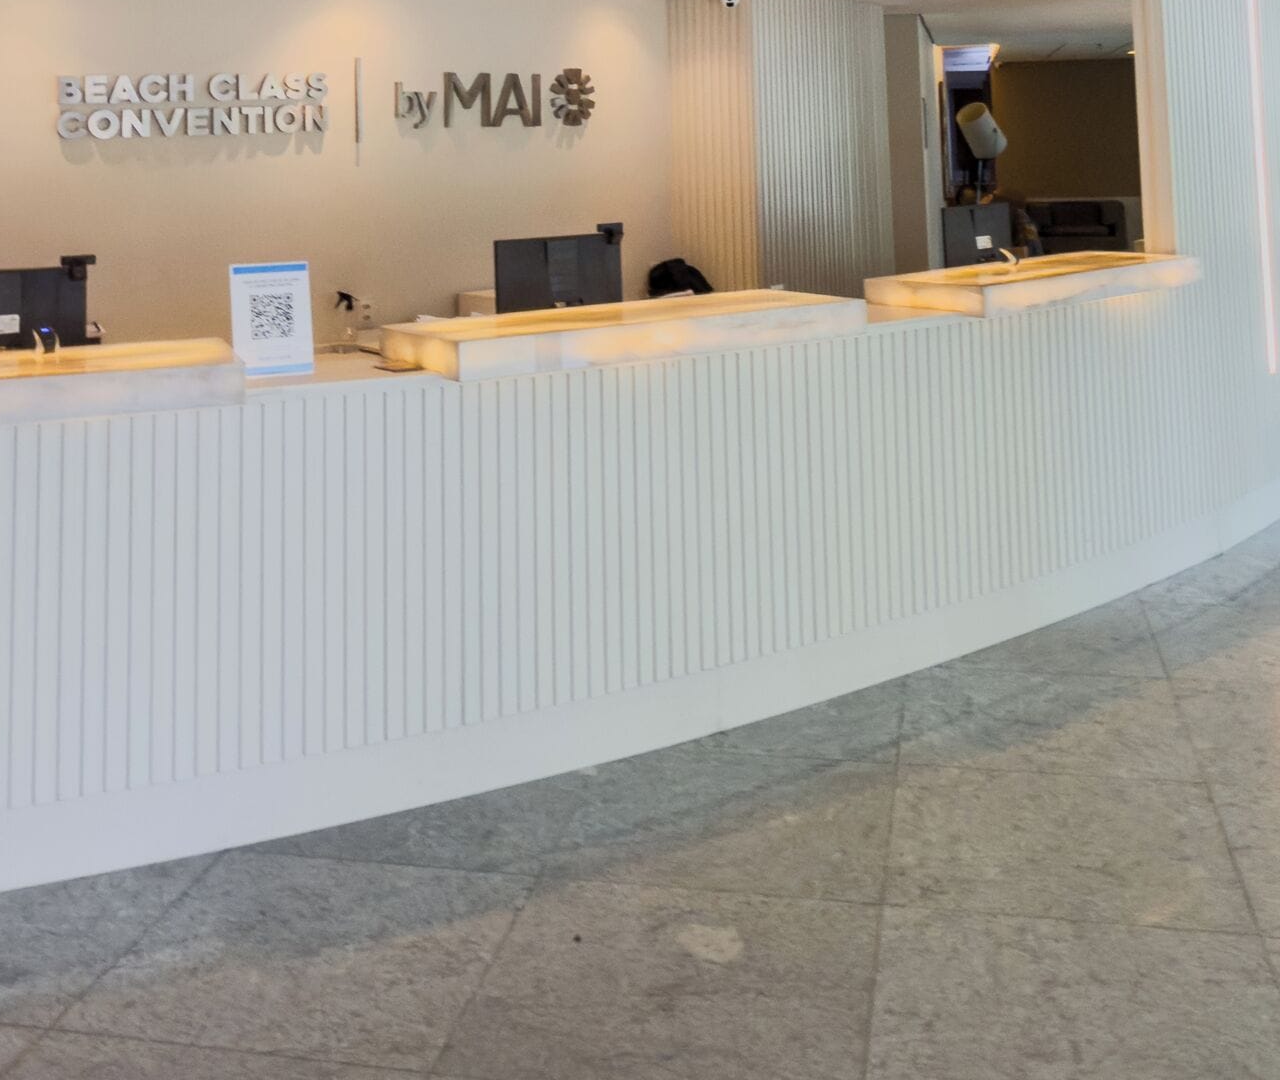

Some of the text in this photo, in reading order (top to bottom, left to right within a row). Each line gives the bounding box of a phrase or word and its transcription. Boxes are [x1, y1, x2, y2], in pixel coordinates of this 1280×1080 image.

[58, 72, 328, 104] BEACH CLASS
[394, 72, 542, 129] by MAI
[57, 105, 328, 140] CONVENTION
